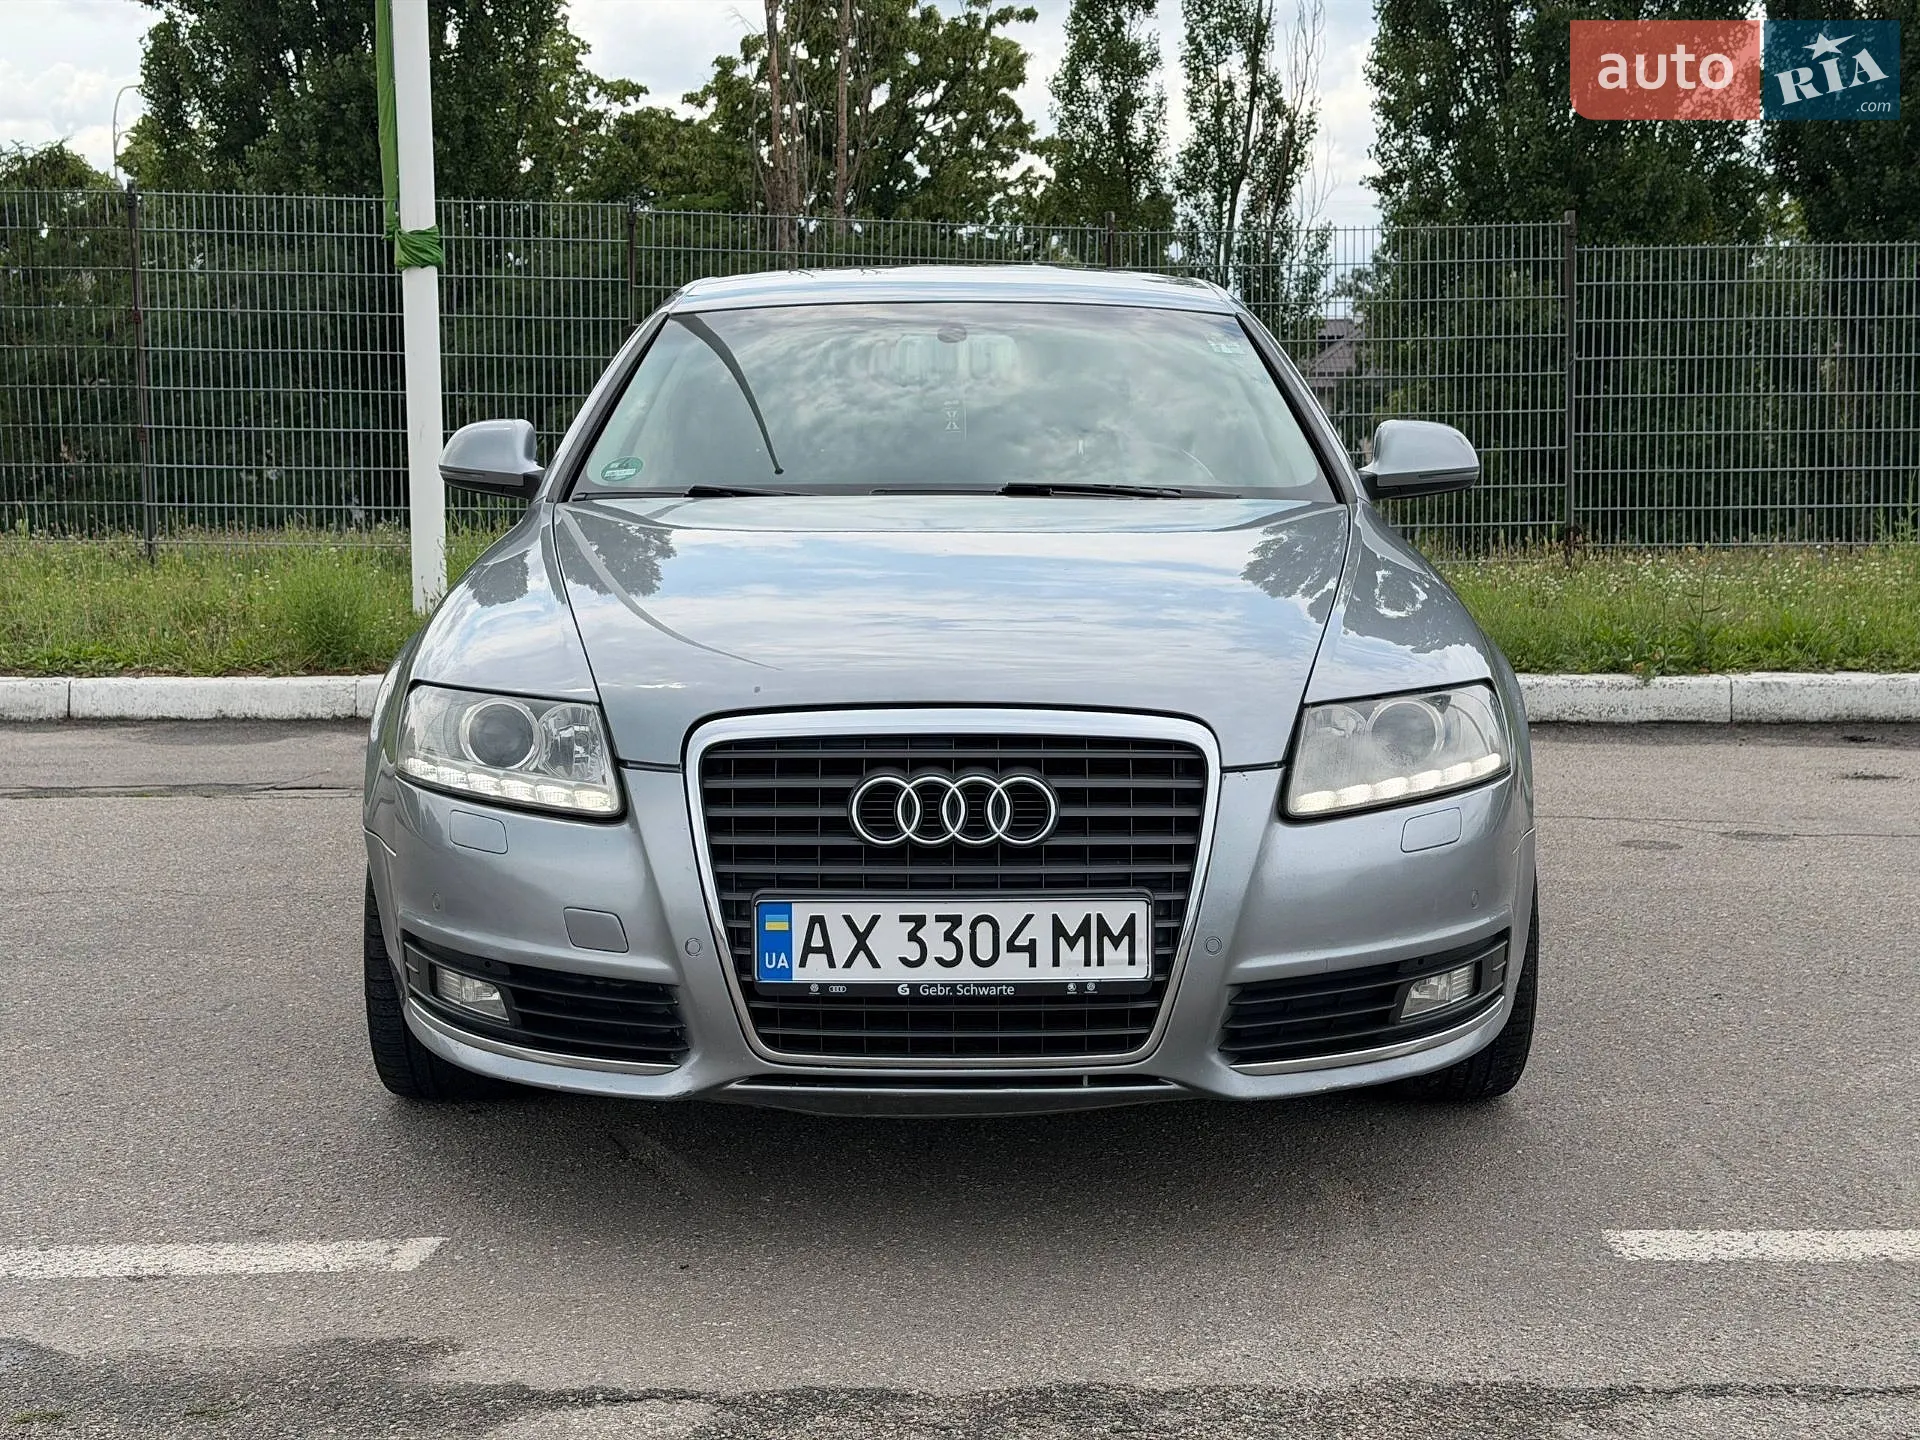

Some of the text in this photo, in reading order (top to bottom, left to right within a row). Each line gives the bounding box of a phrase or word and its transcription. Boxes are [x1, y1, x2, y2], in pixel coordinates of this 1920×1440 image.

[798, 912, 1136, 969] AX 3304 MM
[765, 952, 789, 969] UA
[919, 983, 953, 996] Gebr.
[956, 983, 1015, 996] Schwarte
